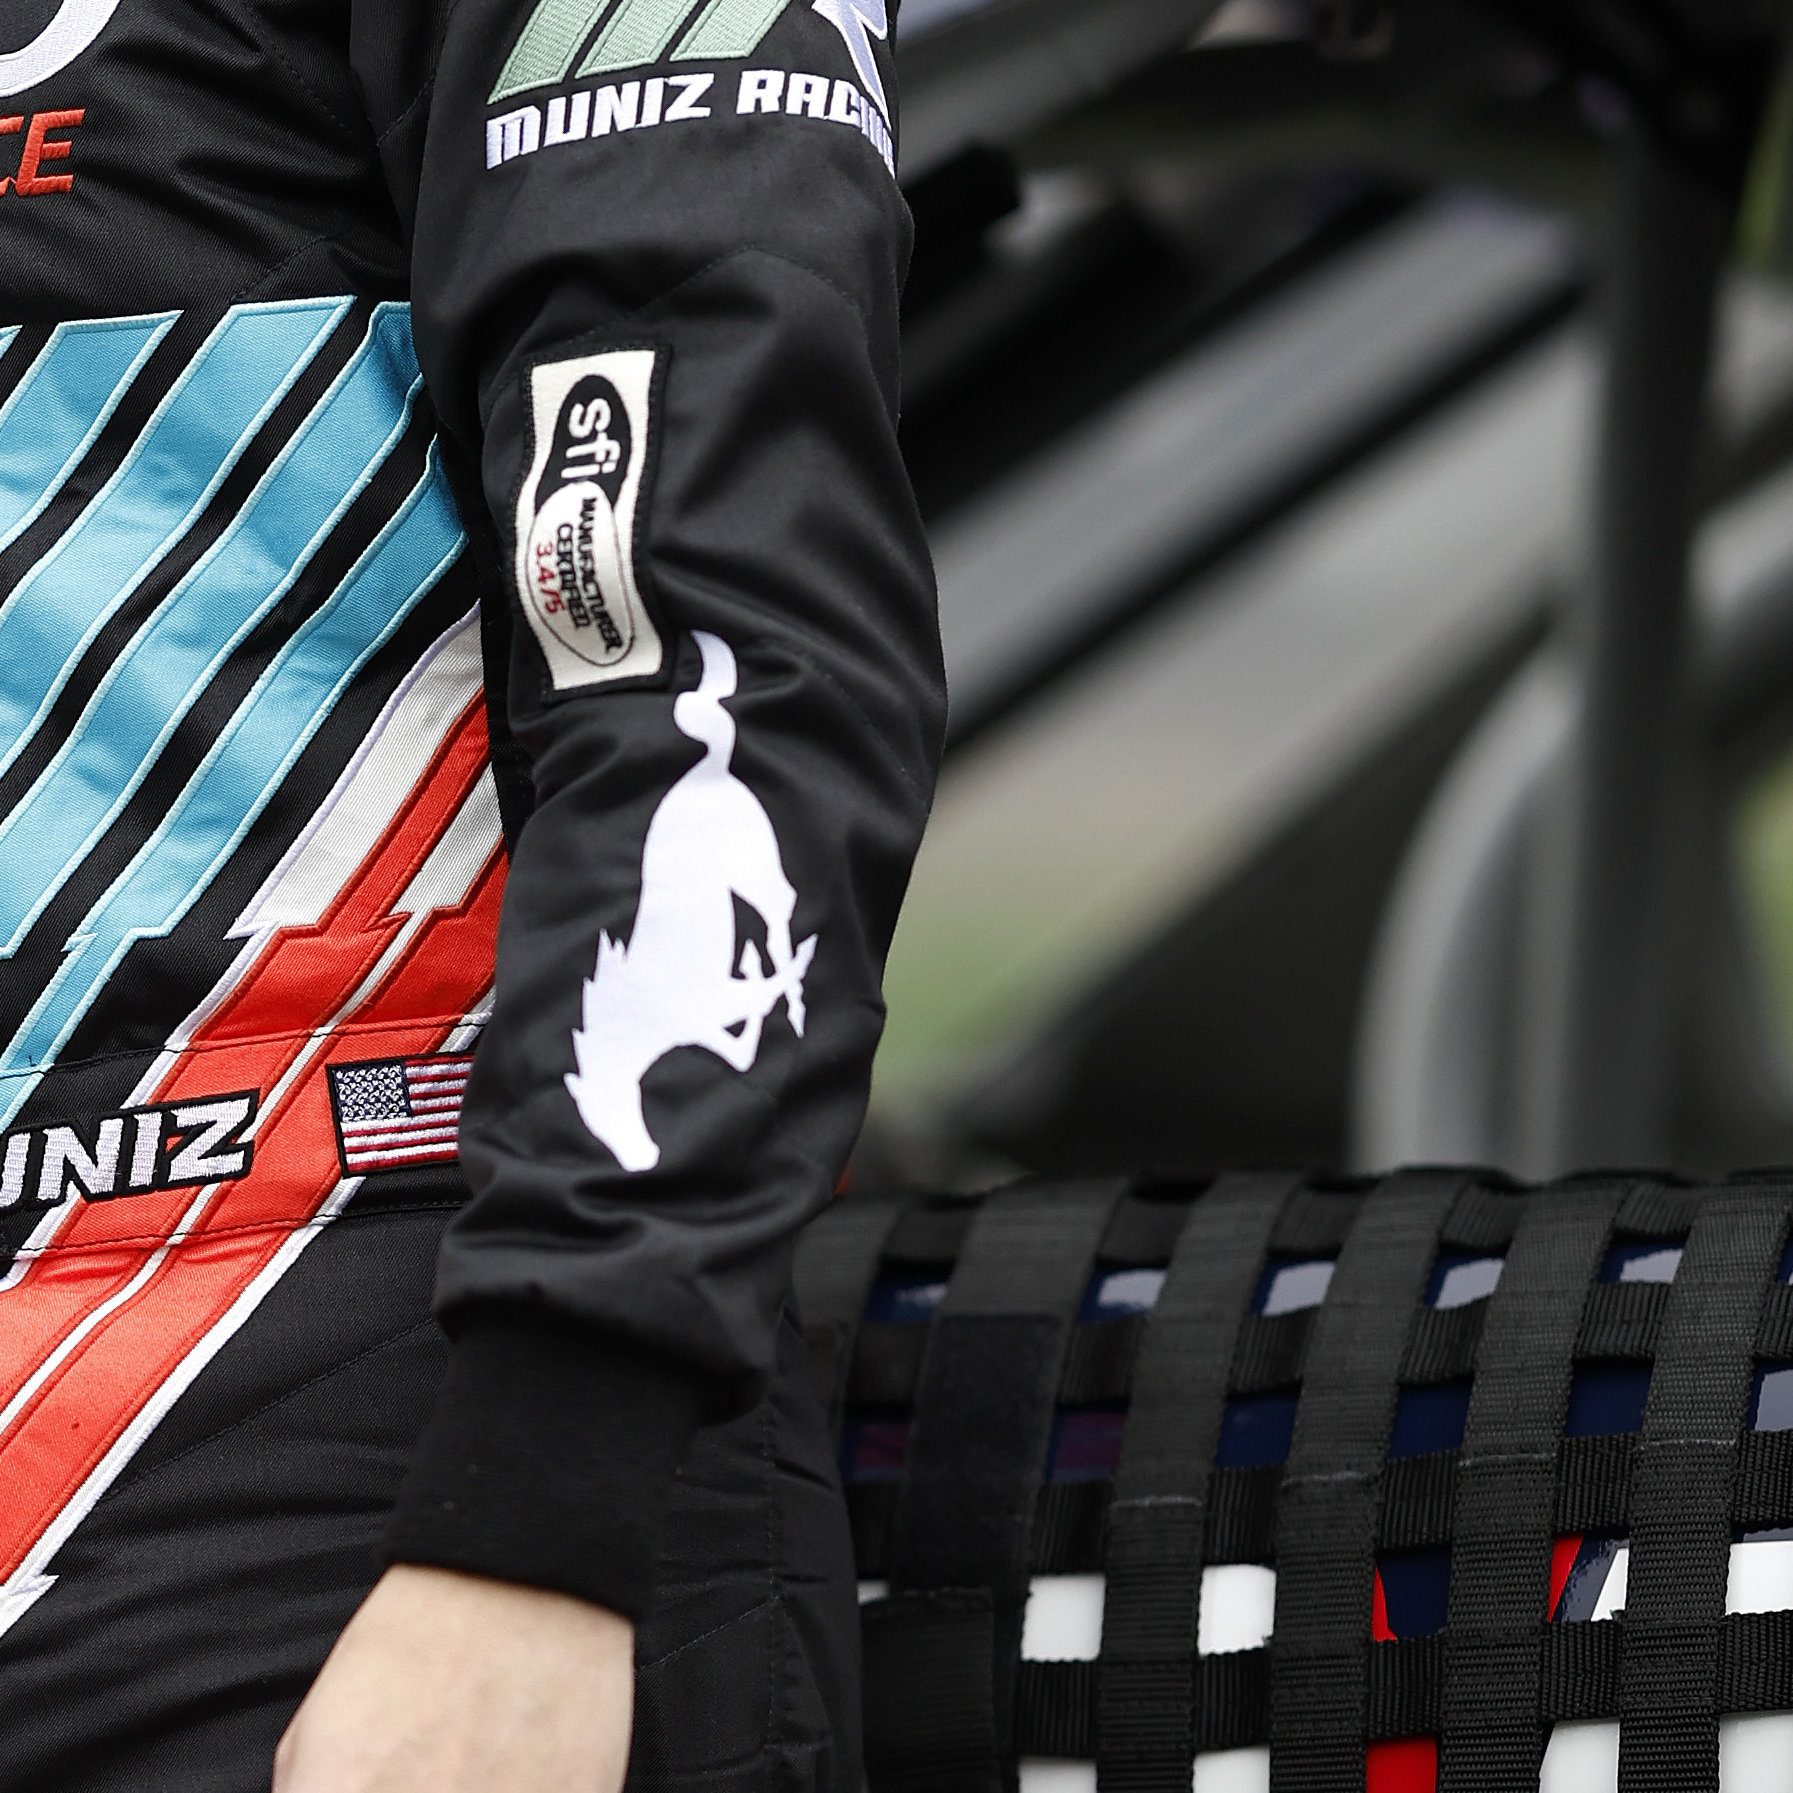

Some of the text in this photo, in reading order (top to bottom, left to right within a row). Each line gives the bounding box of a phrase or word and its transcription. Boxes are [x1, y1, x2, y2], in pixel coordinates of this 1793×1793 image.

[486, 72, 715, 171] MUNIZ
[560, 397, 623, 480] sfi
[536, 540, 567, 615] 3.4/5
[556, 522, 593, 630] CERTIFIED
